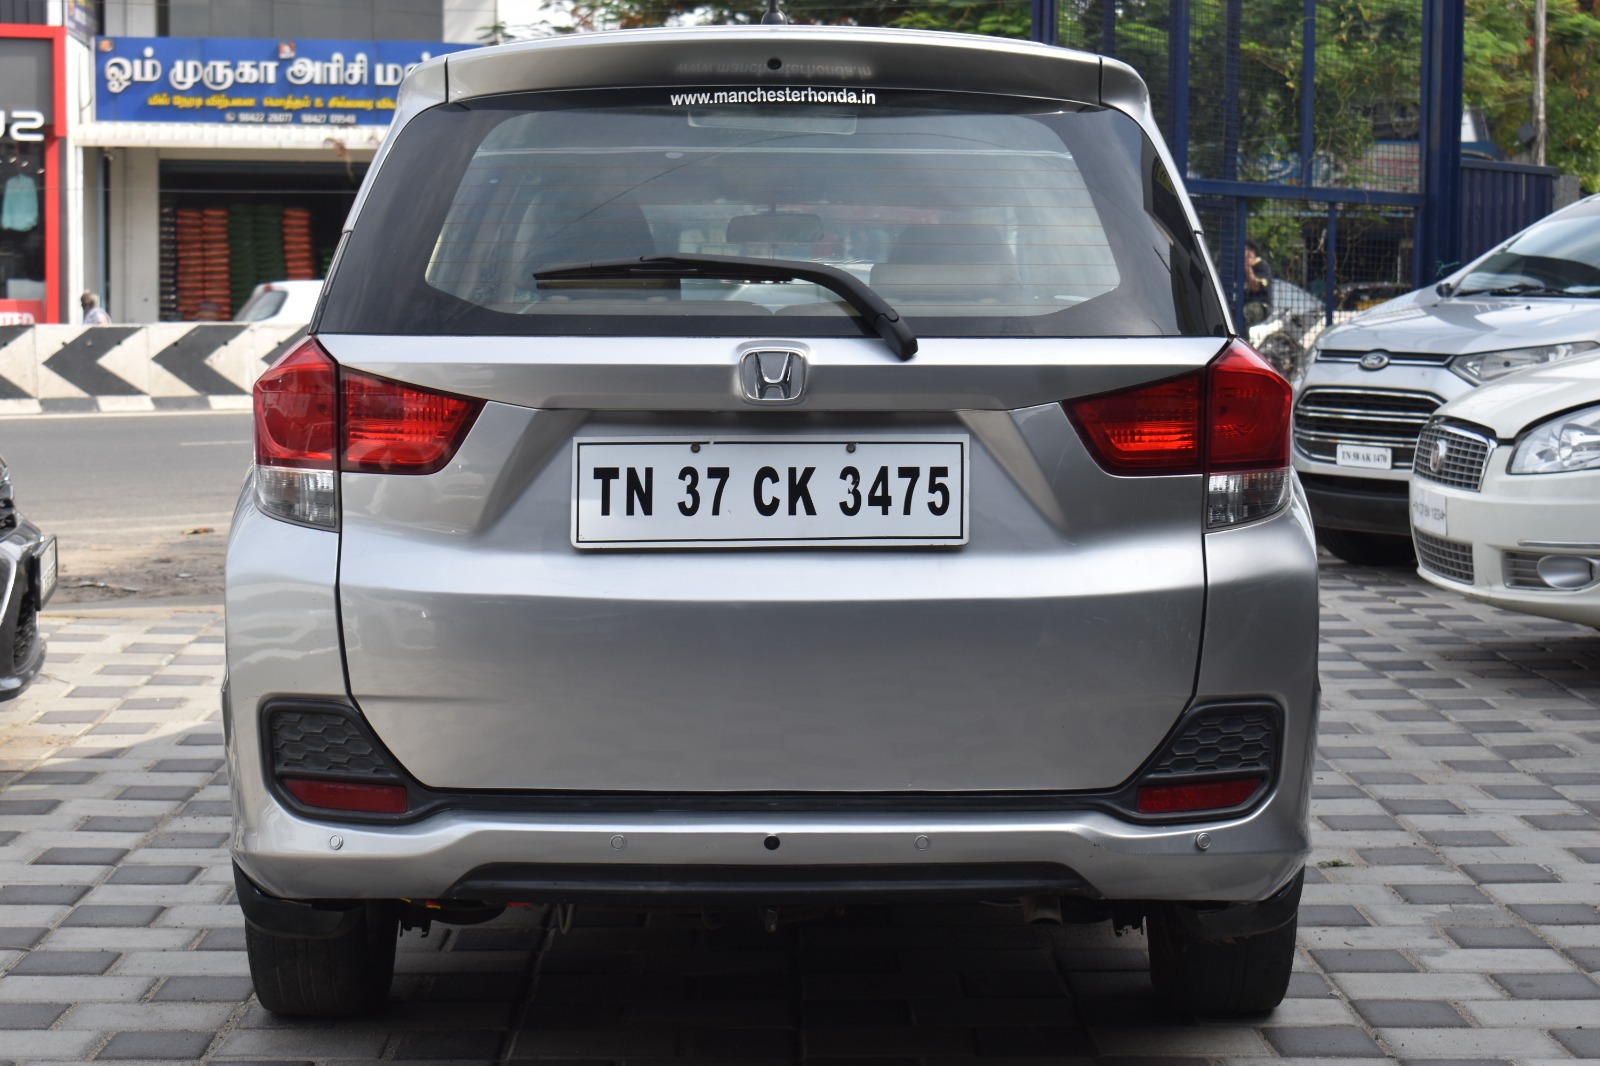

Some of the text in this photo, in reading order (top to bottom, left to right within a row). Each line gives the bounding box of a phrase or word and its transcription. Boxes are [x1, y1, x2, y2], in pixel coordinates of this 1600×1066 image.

[105, 47, 162, 93] ஓம்
[169, 60, 279, 90] முருகா
[286, 52, 368, 85] அரிசி
[670, 87, 876, 106] www.manchesterhonda.in
[593, 466, 950, 517] TN 37 CK 3475
